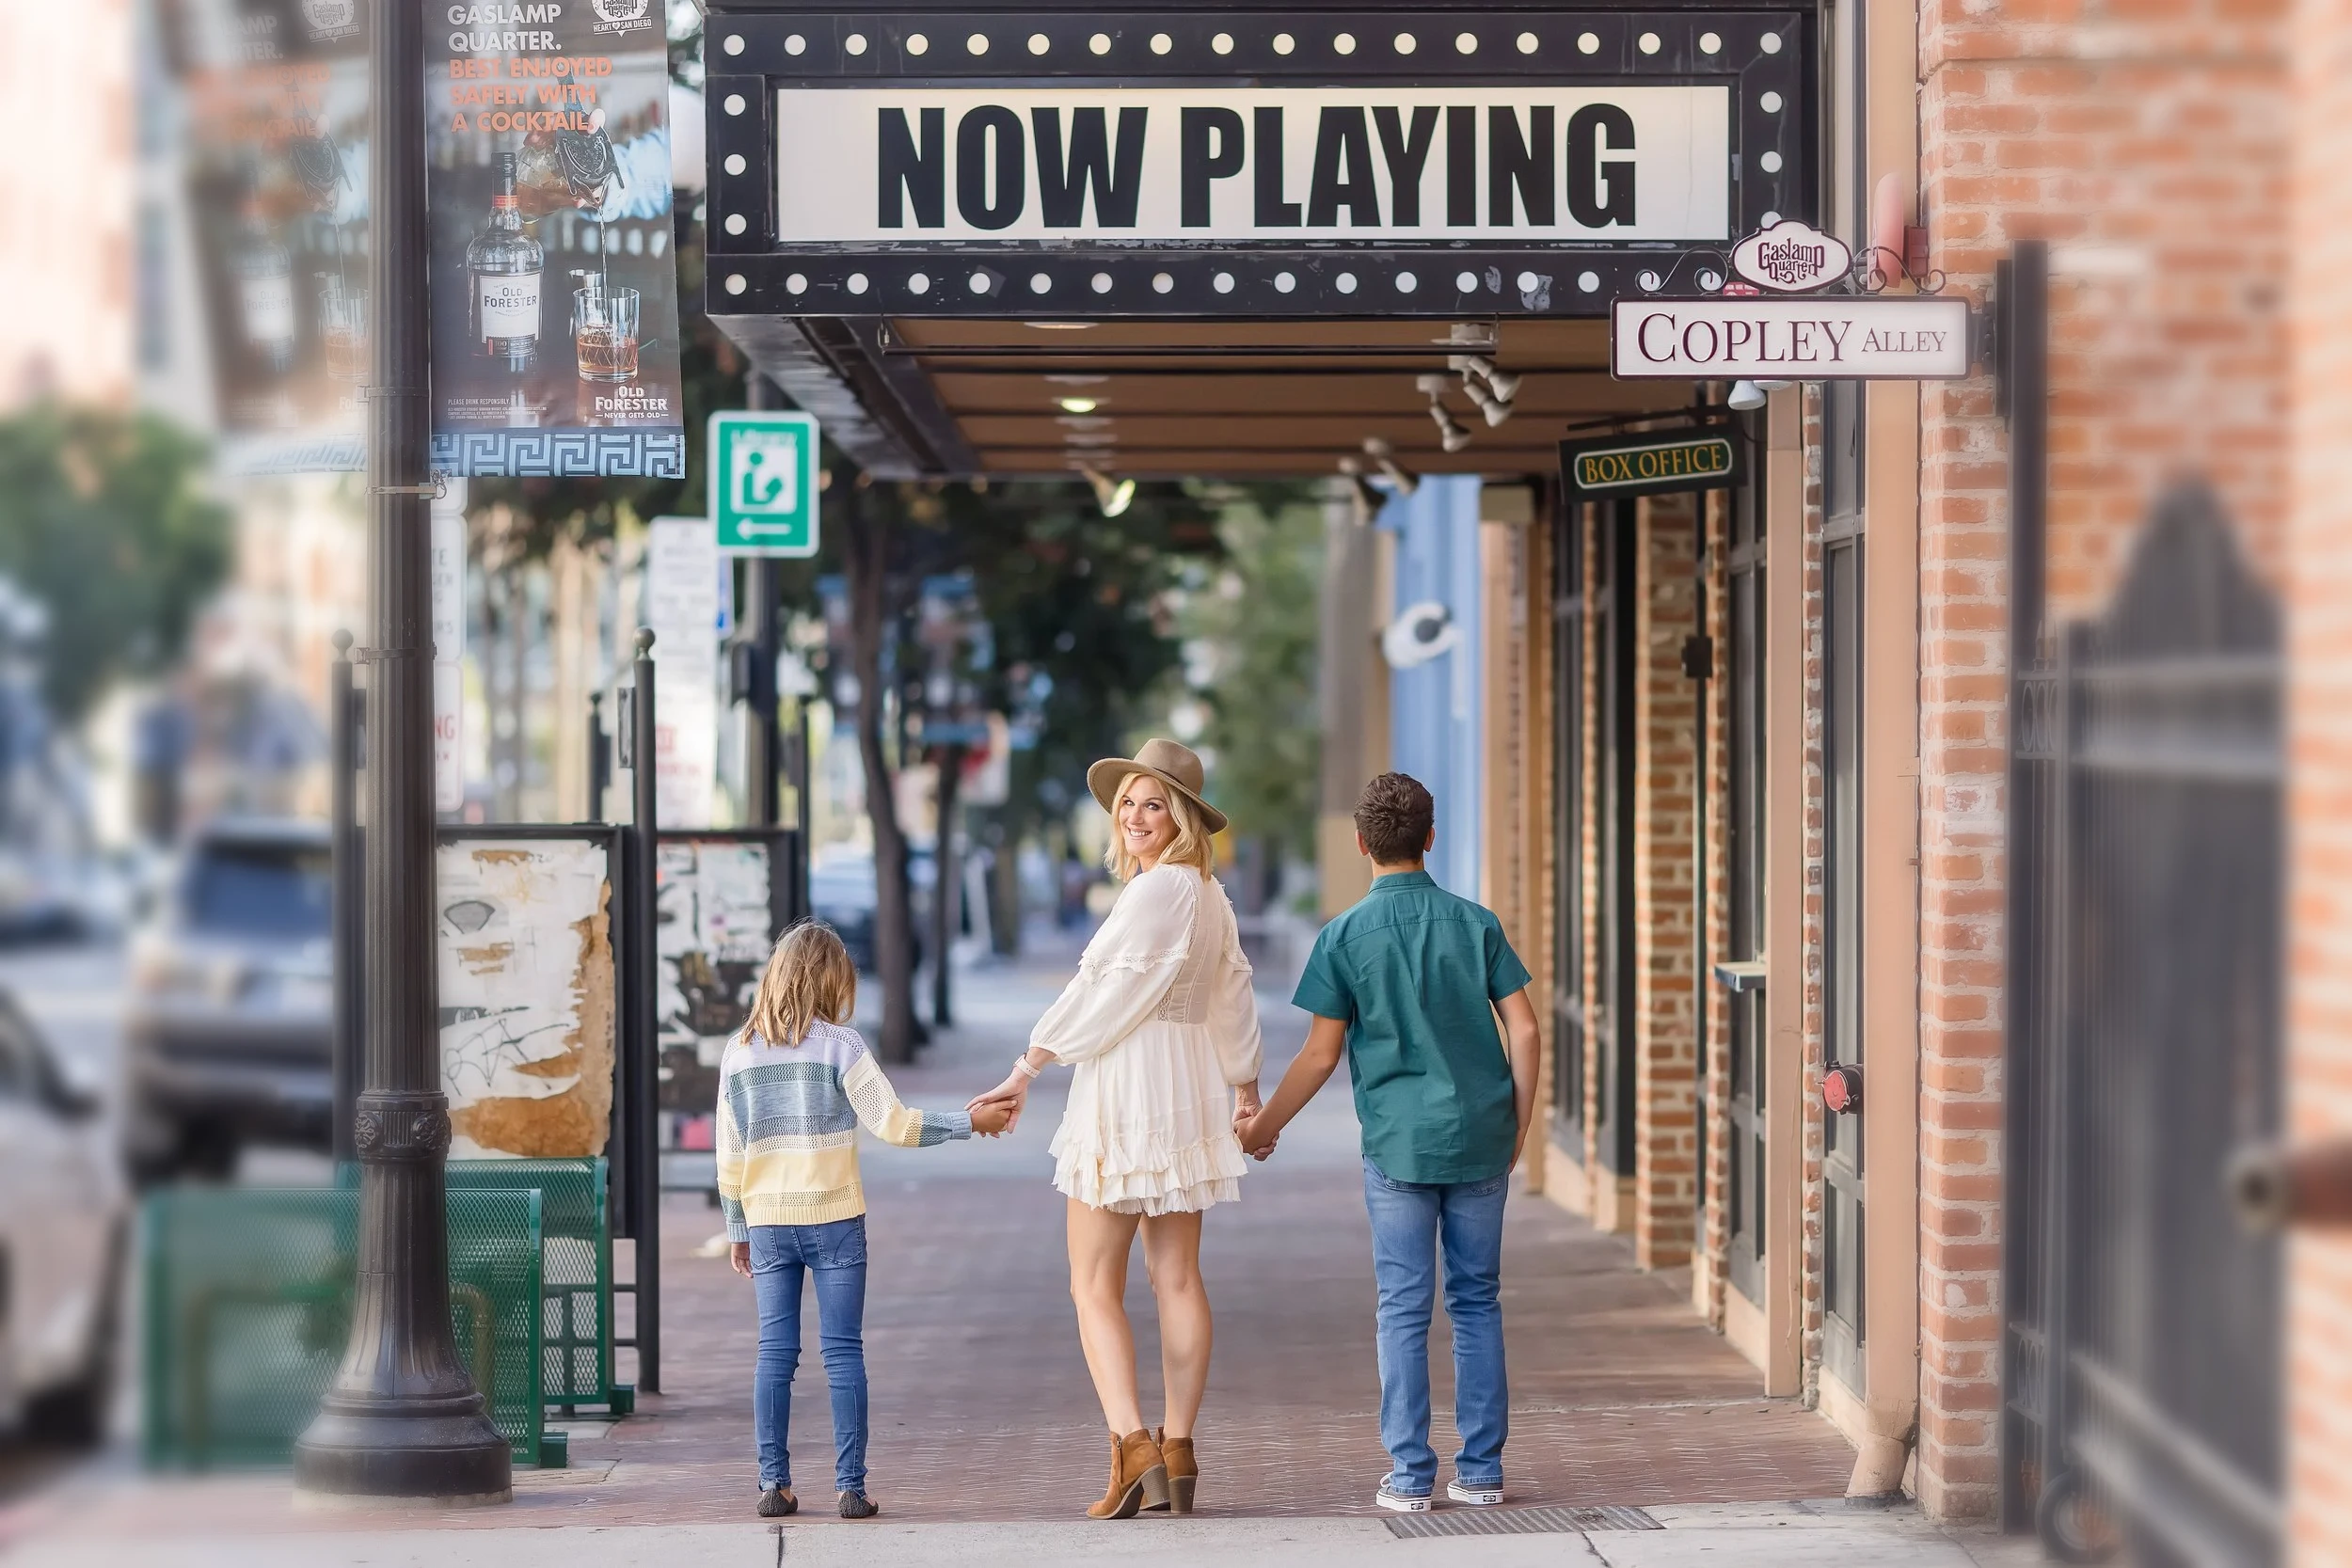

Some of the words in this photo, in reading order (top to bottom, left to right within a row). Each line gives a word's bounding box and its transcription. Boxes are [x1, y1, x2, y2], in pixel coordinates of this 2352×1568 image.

[447, 4, 562, 25] GASLAMP
[308, 30, 326, 40] HEART
[332, 27, 344, 37] SAN
[344, 24, 360, 35] DIEGO
[593, 23, 612, 33] HEART
[621, 20, 633, 30] SAN
[633, 18, 652, 29] DIEGO
[448, 31, 563, 53] QUARTER.
[450, 58, 501, 79] BEST
[510, 56, 612, 79] ENJOYED
[451, 84, 531, 105] SAFELY
[537, 84, 596, 105] WITH
[451, 112, 469, 133] A
[878, 104, 1149, 230] NOW
[1181, 103, 1636, 230] PLAYING
[1757, 237, 1825, 270] Gaslamp
[1768, 259, 1820, 284] Quarter
[484, 294, 537, 309] FORESTER
[502, 287, 523, 297] OLD
[1637, 312, 1853, 364] COPLEY
[1861, 326, 1947, 353] ALLEY
[618, 385, 644, 399] OLD
[595, 396, 668, 412] FORESTER
[1584, 453, 1634, 483] BOX
[1638, 444, 1724, 478] OFFICE
